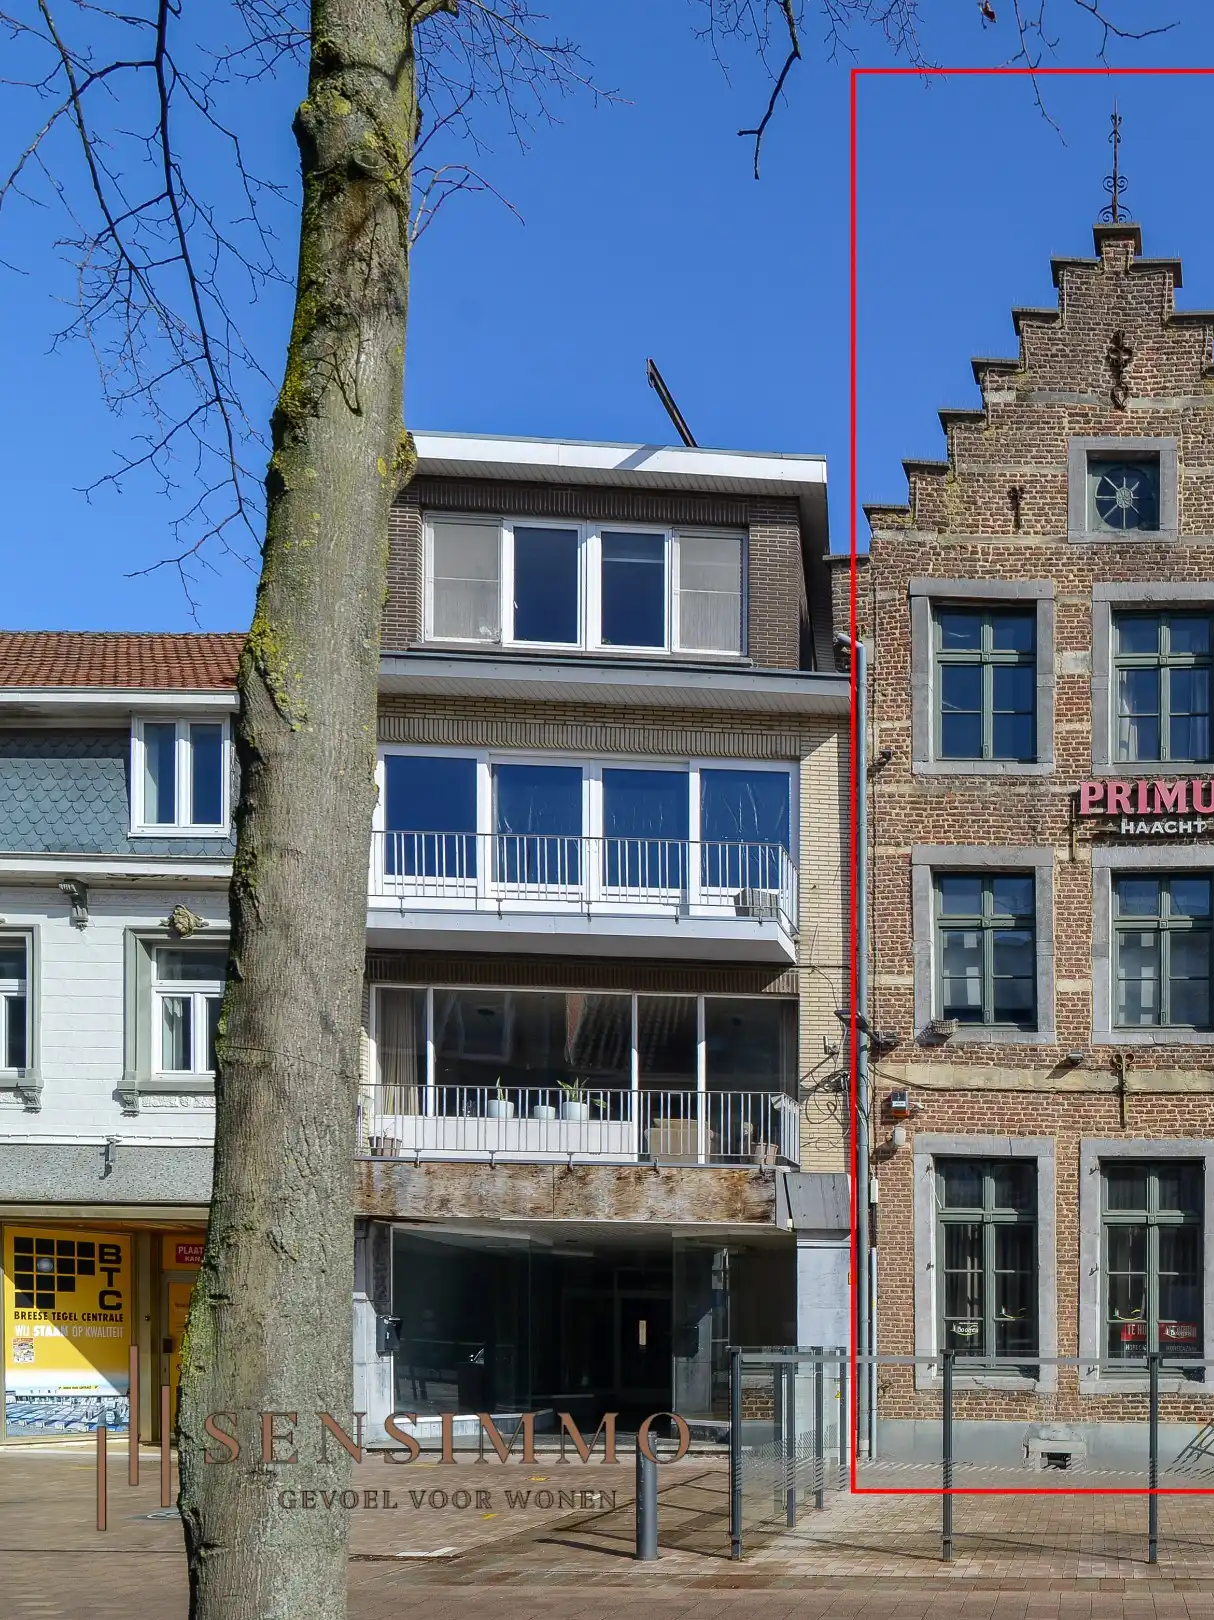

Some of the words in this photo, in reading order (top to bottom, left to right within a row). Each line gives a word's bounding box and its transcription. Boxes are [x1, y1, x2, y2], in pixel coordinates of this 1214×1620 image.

[1121, 820, 1206, 834] HAACHT
[178, 1246, 205, 1255] PLAAT
[98, 1243, 123, 1311] BTC
[14, 1311, 48, 1320] BREESE
[52, 1311, 78, 1321] TEGEL
[82, 1312, 124, 1323] CENTRALE
[33, 1324, 69, 1337] STAAN
[72, 1326, 83, 1337] OP
[85, 1325, 124, 1338] KWALITEIT
[1127, 1324, 1135, 1336] TE
[1138, 1324, 1147, 1336] HU
